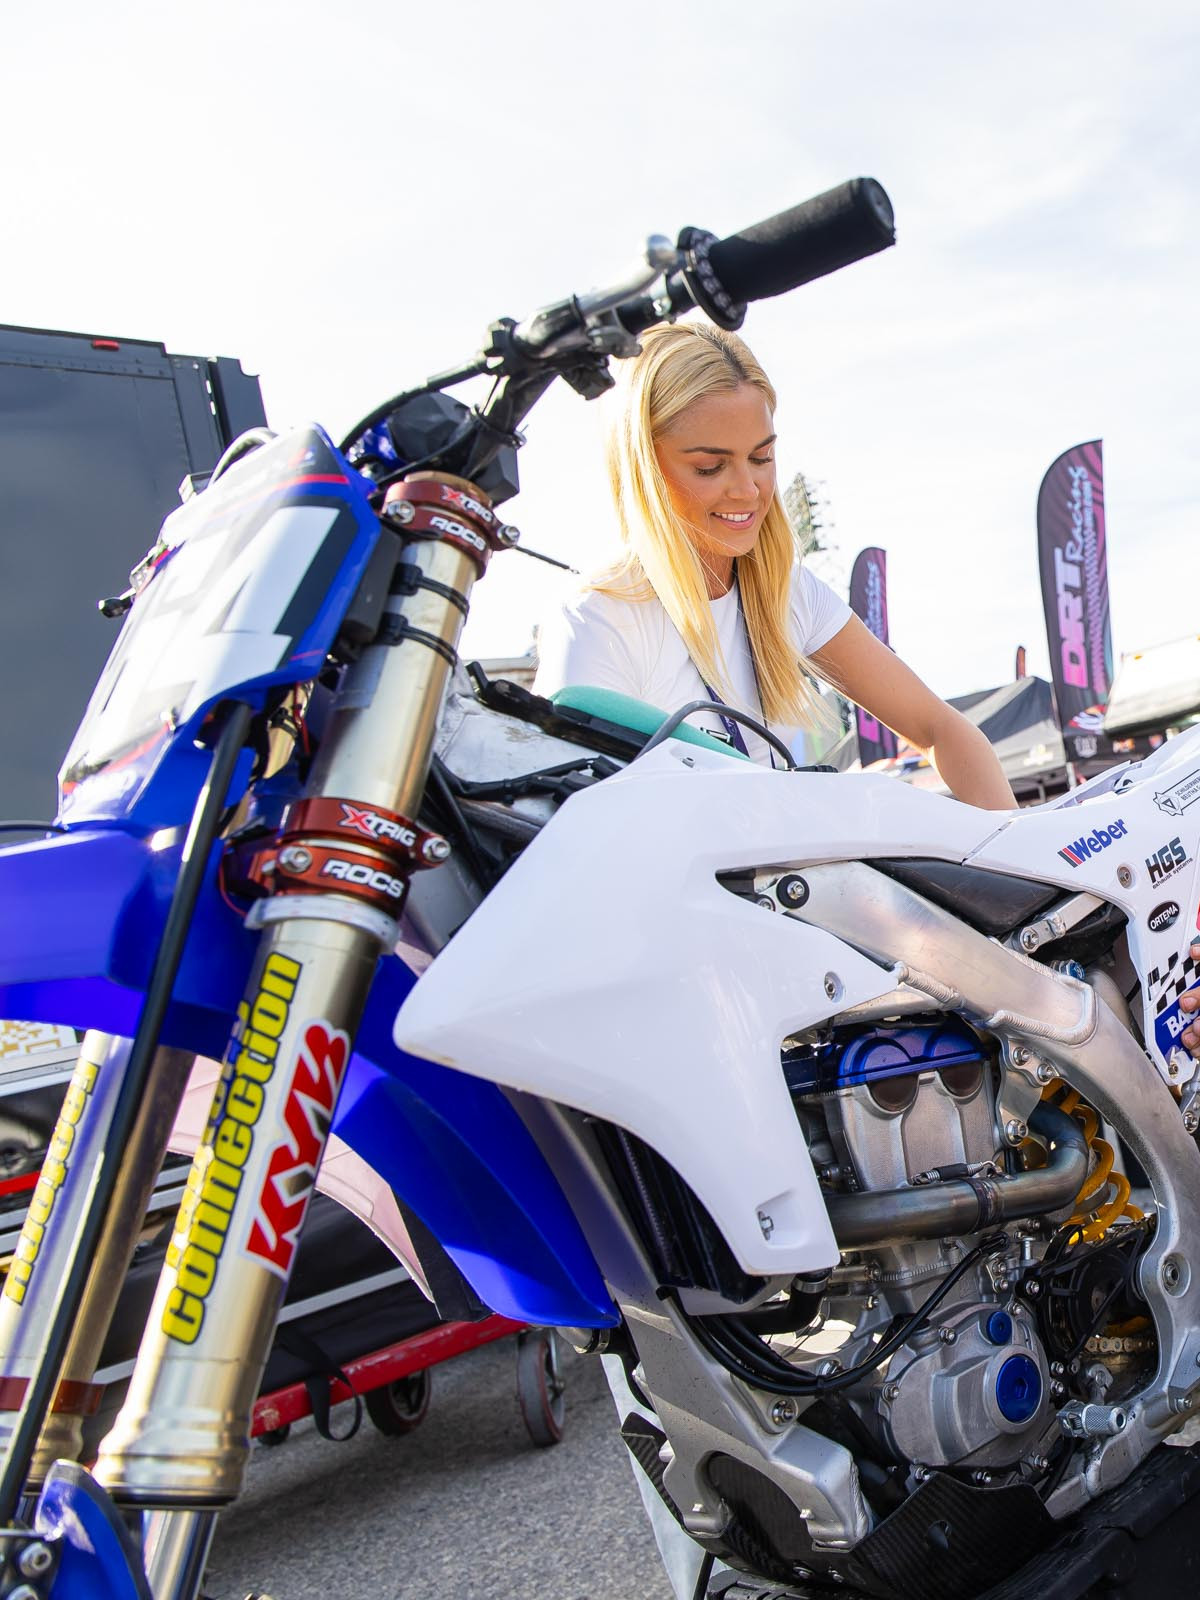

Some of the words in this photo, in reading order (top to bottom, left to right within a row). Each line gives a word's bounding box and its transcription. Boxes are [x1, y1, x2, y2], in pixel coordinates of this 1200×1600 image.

[429, 516, 487, 551] ROCS
[1054, 547, 1088, 688] DRT
[337, 803, 417, 848] XTRIG
[1066, 818, 1128, 862] Weber
[318, 859, 405, 898] ROCS
[1145, 837, 1187, 884] HGS
[1152, 872, 1172, 889] exhaust
[1150, 904, 1179, 930] ORTEMA
[245, 1022, 349, 1274] KYB
